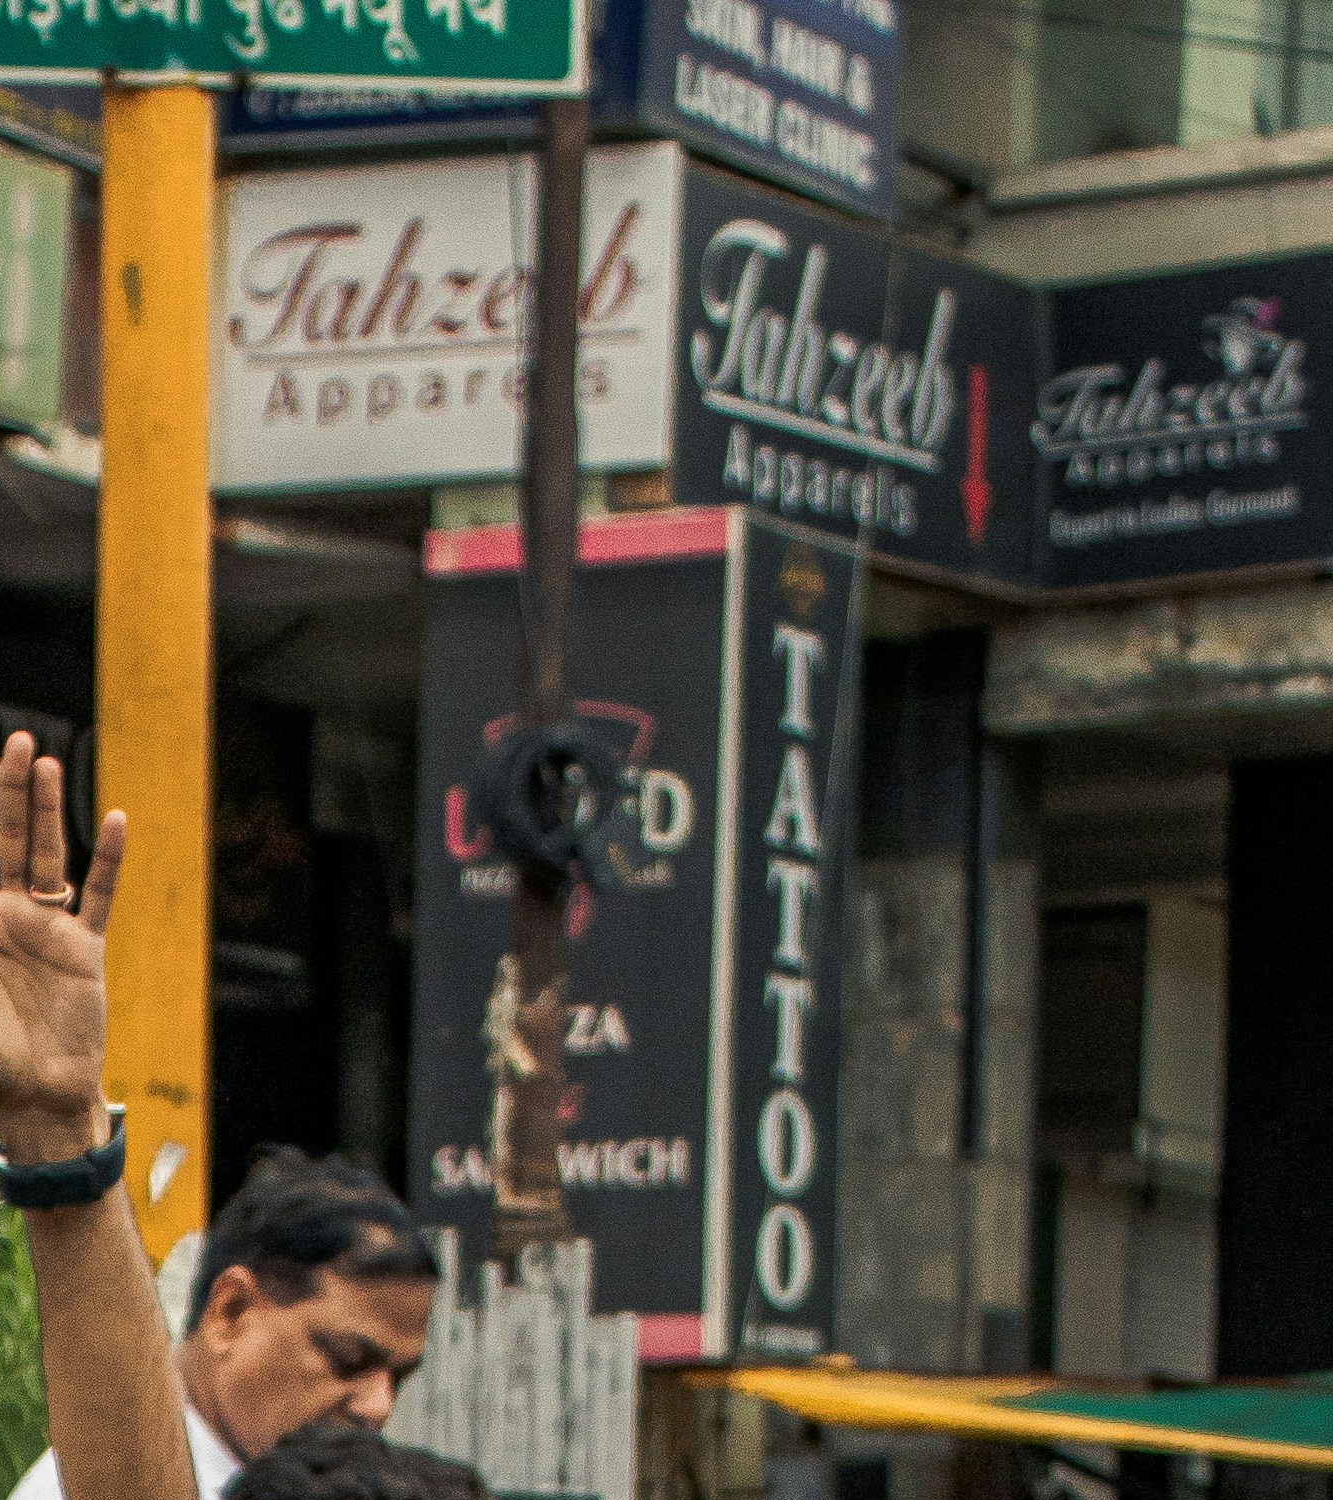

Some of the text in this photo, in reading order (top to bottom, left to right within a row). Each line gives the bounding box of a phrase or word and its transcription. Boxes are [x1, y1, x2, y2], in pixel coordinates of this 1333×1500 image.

[227, 200, 640, 352] Tahzeb
[263, 356, 613, 427] Appares
[753, 620, 825, 1311] TATTOO
[431, 1130, 690, 1194] SAWICH
